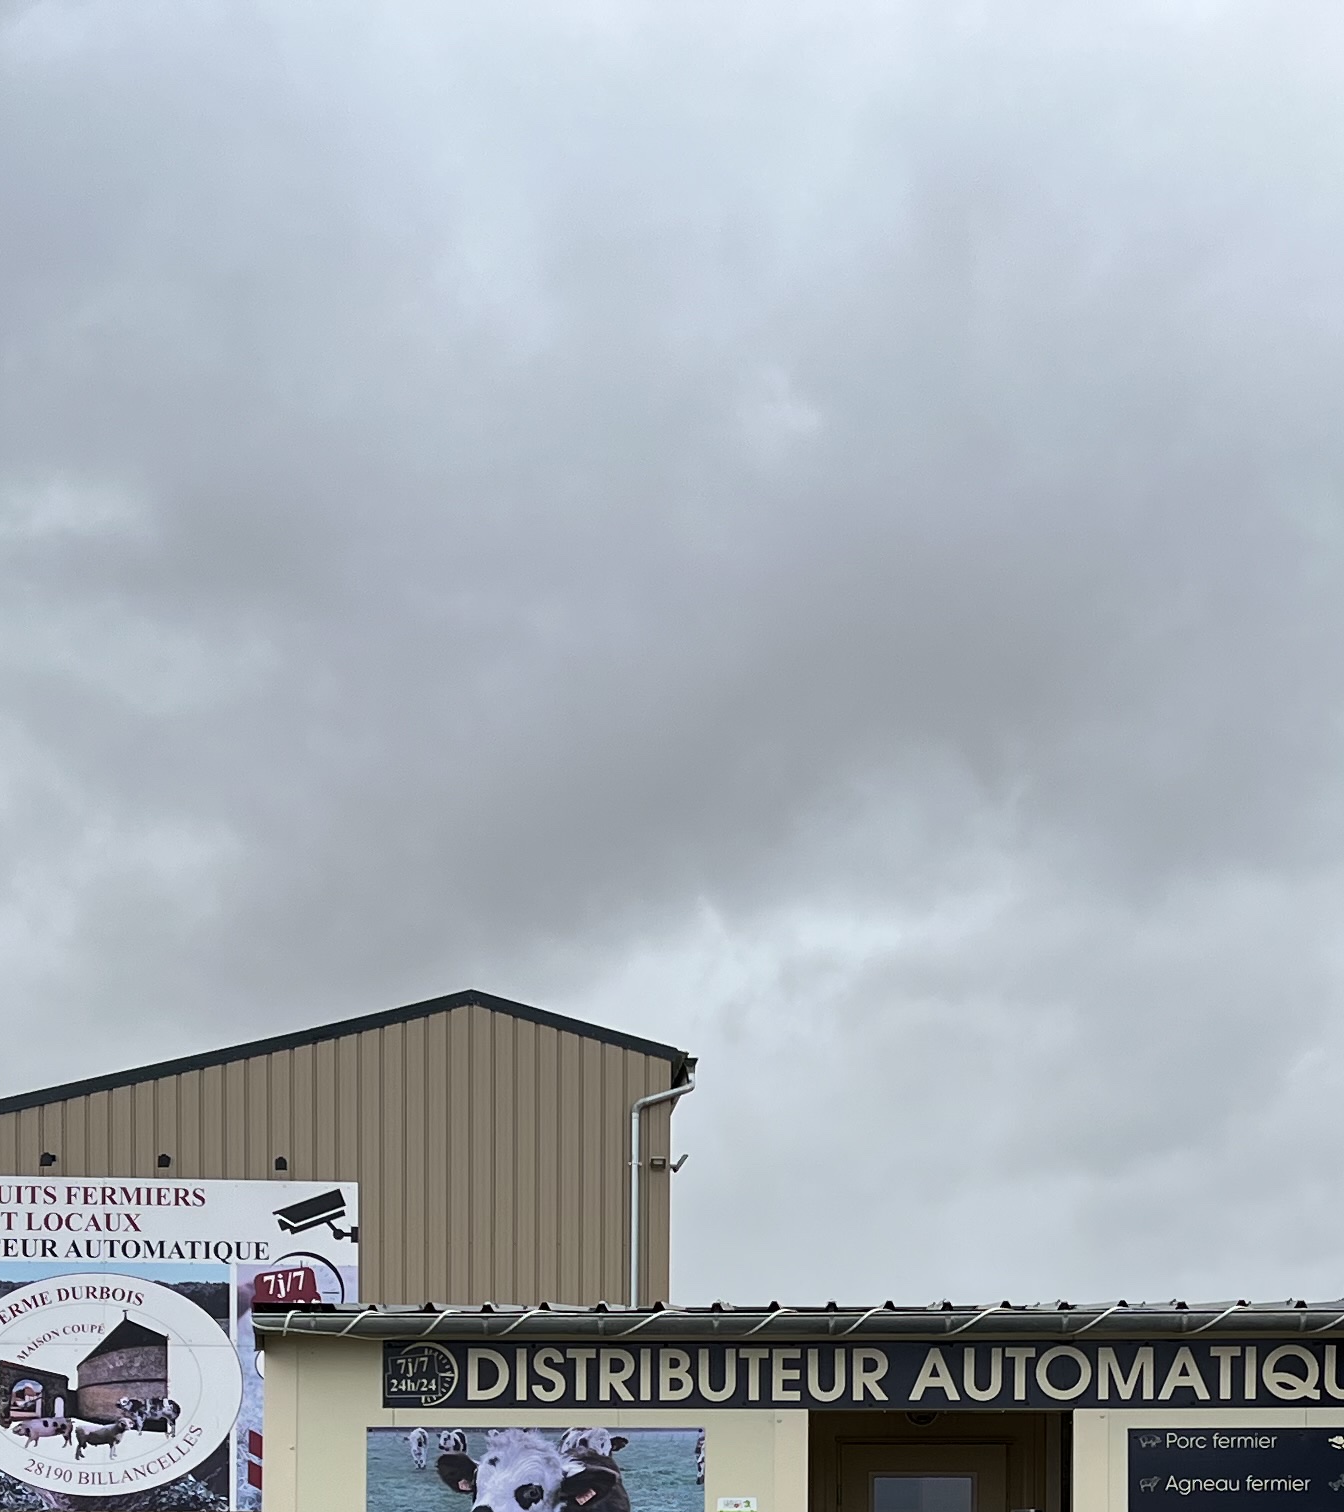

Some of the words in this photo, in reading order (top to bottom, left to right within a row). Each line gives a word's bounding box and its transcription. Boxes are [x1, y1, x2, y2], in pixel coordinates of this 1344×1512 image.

[65, 1186, 206, 1206] FERMIERS
[26, 1212, 142, 1232] LOCAUX
[64, 1240, 269, 1264] AUTOMATIQUE
[264, 1271, 304, 1298] 7j/7
[56, 1286, 144, 1306] DURBOIS
[17, 1329, 60, 1362] MAISON
[62, 1323, 105, 1335] COUPÉ
[396, 1357, 428, 1377] 7j/7
[467, 1346, 889, 1402] DISTRIBUTEUR
[390, 1379, 436, 1392] 24h/24
[1166, 1433, 1207, 1448] Porc
[1213, 1433, 1277, 1448] fermier
[24, 1458, 72, 1482] 28190
[78, 1425, 203, 1486] BILLANCELLES
[1165, 1475, 1239, 1495] Agneau
[1246, 1475, 1311, 1491] fermier
